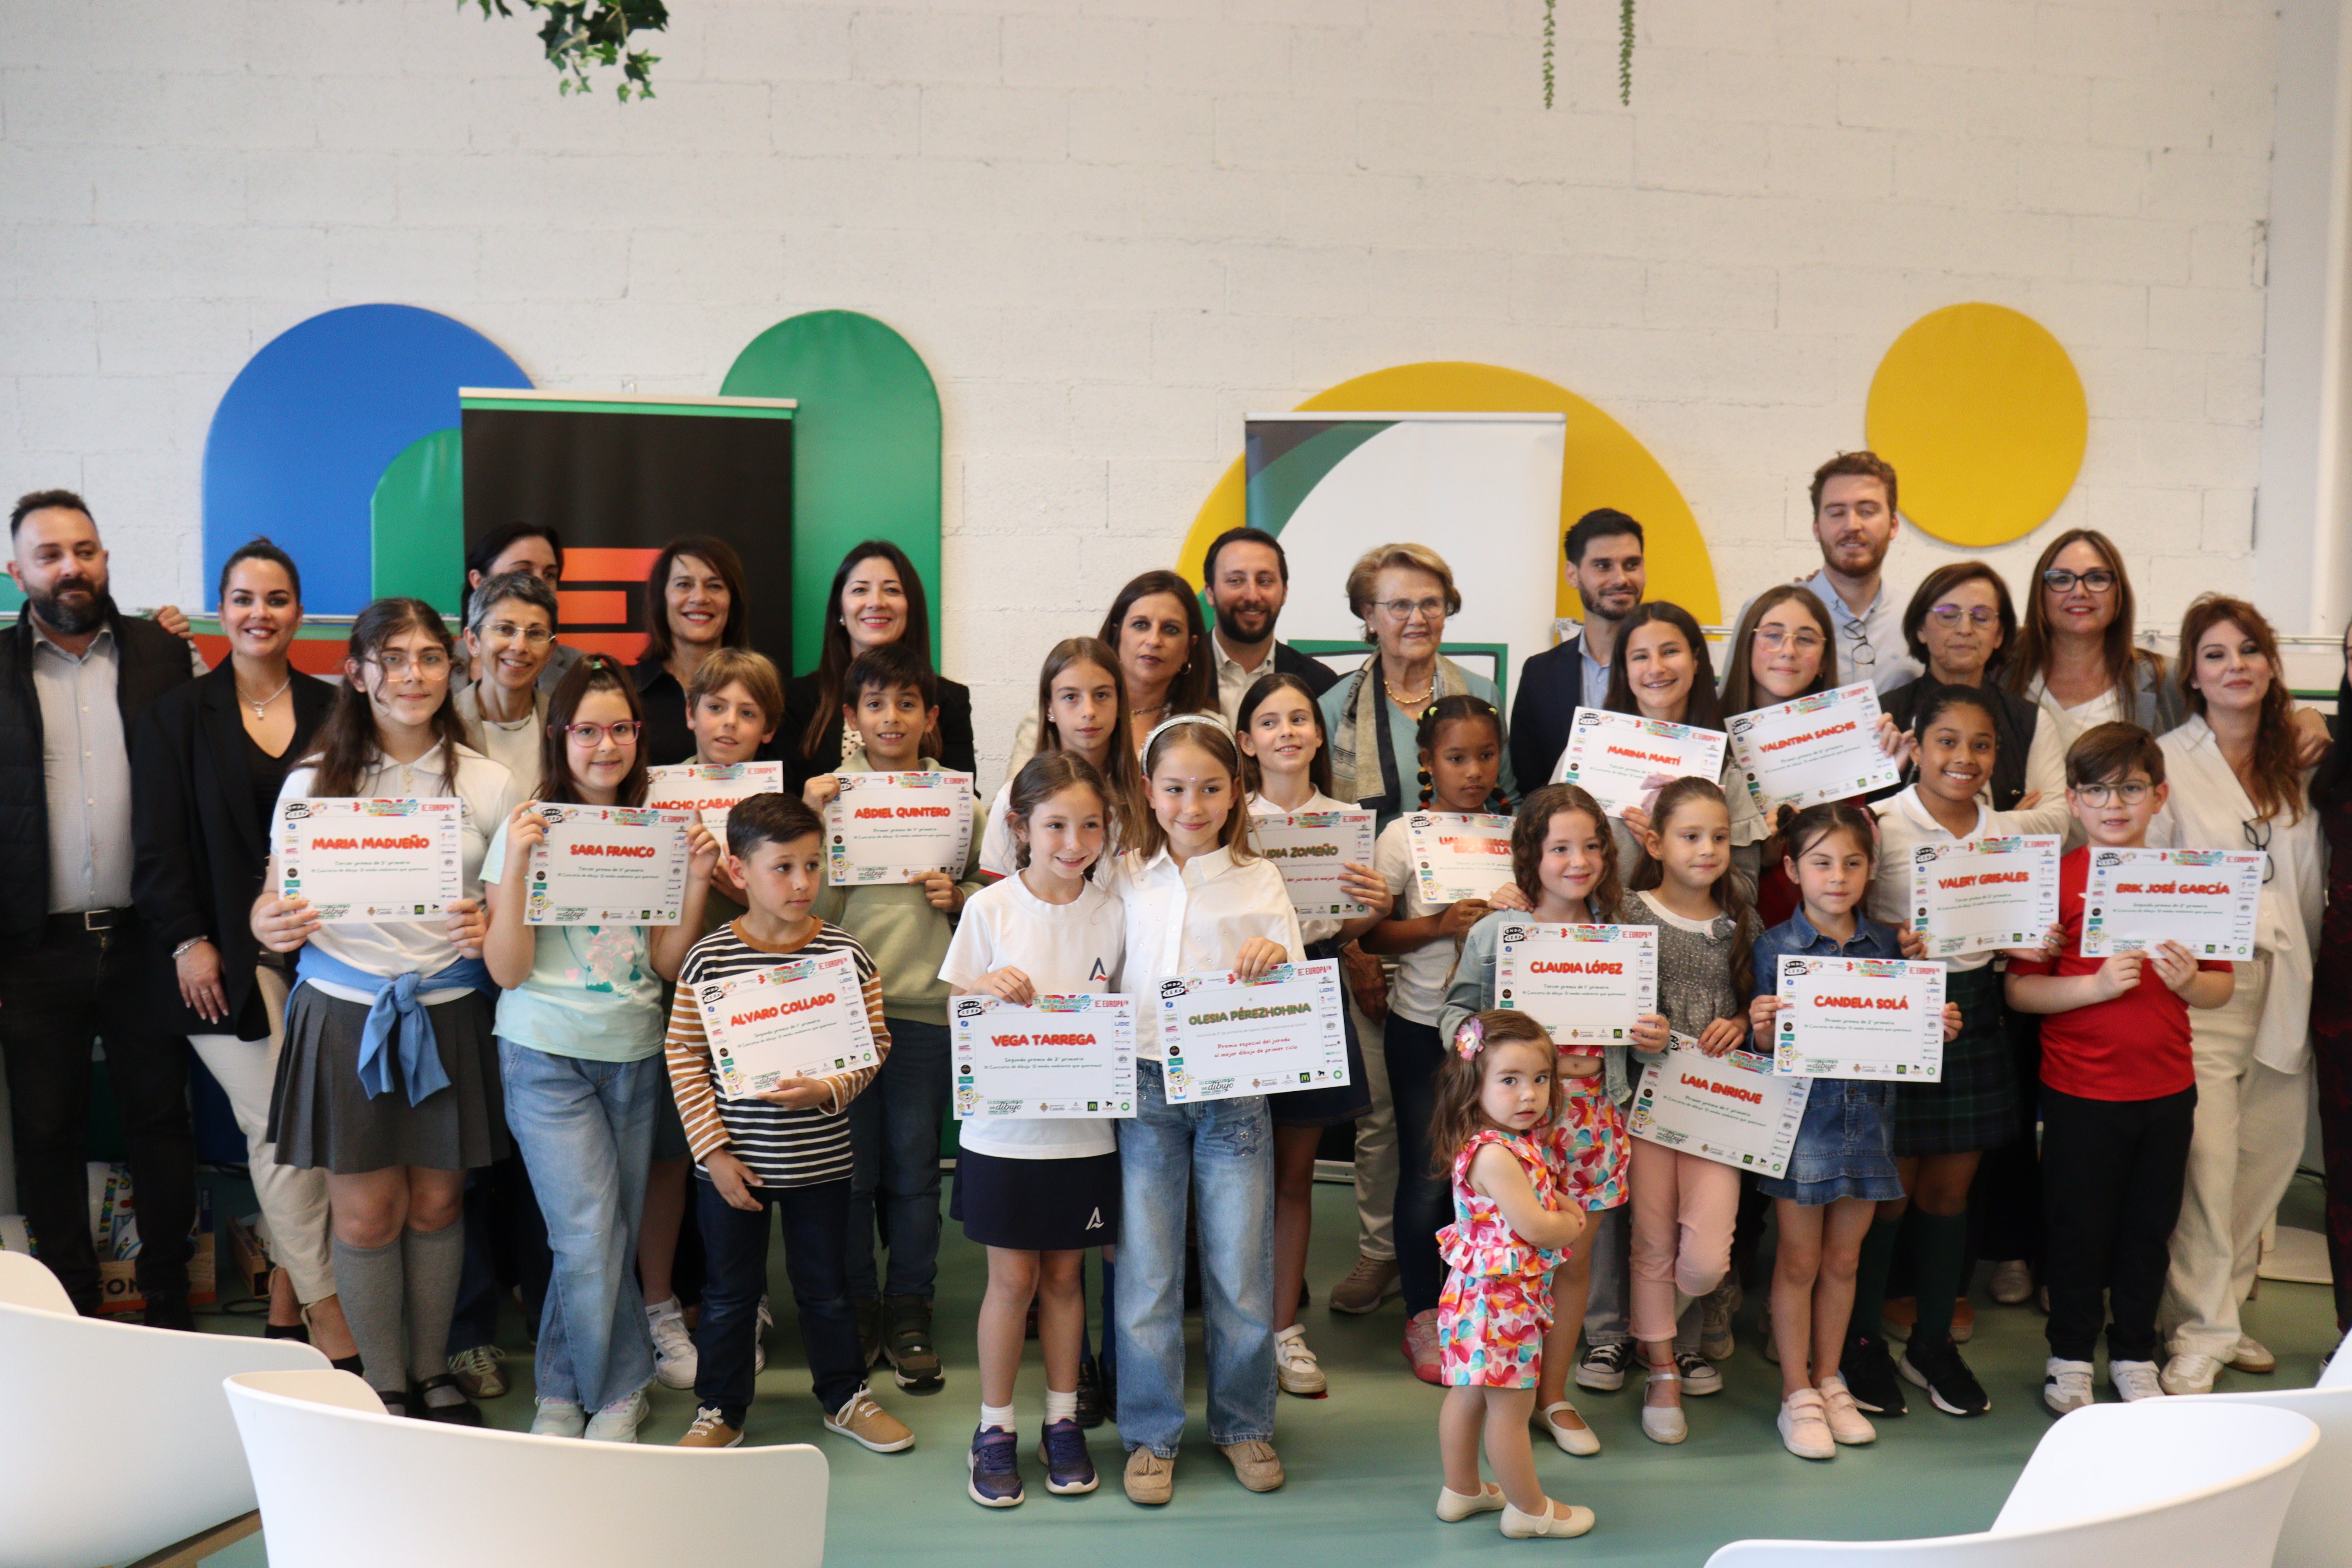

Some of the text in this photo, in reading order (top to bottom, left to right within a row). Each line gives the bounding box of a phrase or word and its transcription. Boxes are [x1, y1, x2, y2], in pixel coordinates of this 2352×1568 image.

[1759, 720, 1856, 753] VALENTINA SANCHIS
[1607, 745, 1681, 766] MARINA MARTÍ
[854, 806, 951, 819] ABDIEL QUINTERO
[311, 833, 430, 850] MARIA MADUEÑO
[570, 843, 655, 858] SARA FRANCO
[1290, 843, 1338, 858] ZOMEÑO
[1938, 871, 2029, 889] VALERY GRISALES
[2116, 880, 2230, 895] ERIK JOSÉ GARCÍA
[1305, 966, 1327, 975] EUROPA
[1530, 959, 1623, 975] CLAUDIA LÓPEZ
[1162, 981, 1182, 989] ONDA
[730, 992, 836, 1026] ALVARO COLLADO
[1814, 995, 1909, 1010] CANDELA SOLÁ
[1189, 1011, 1228, 1024] OLESIA
[991, 1033, 1096, 1047] VEGA TARREGA
[1207, 1080, 1234, 1094] dibujo
[1680, 1072, 1762, 1104] LAIA ENRIQUE
